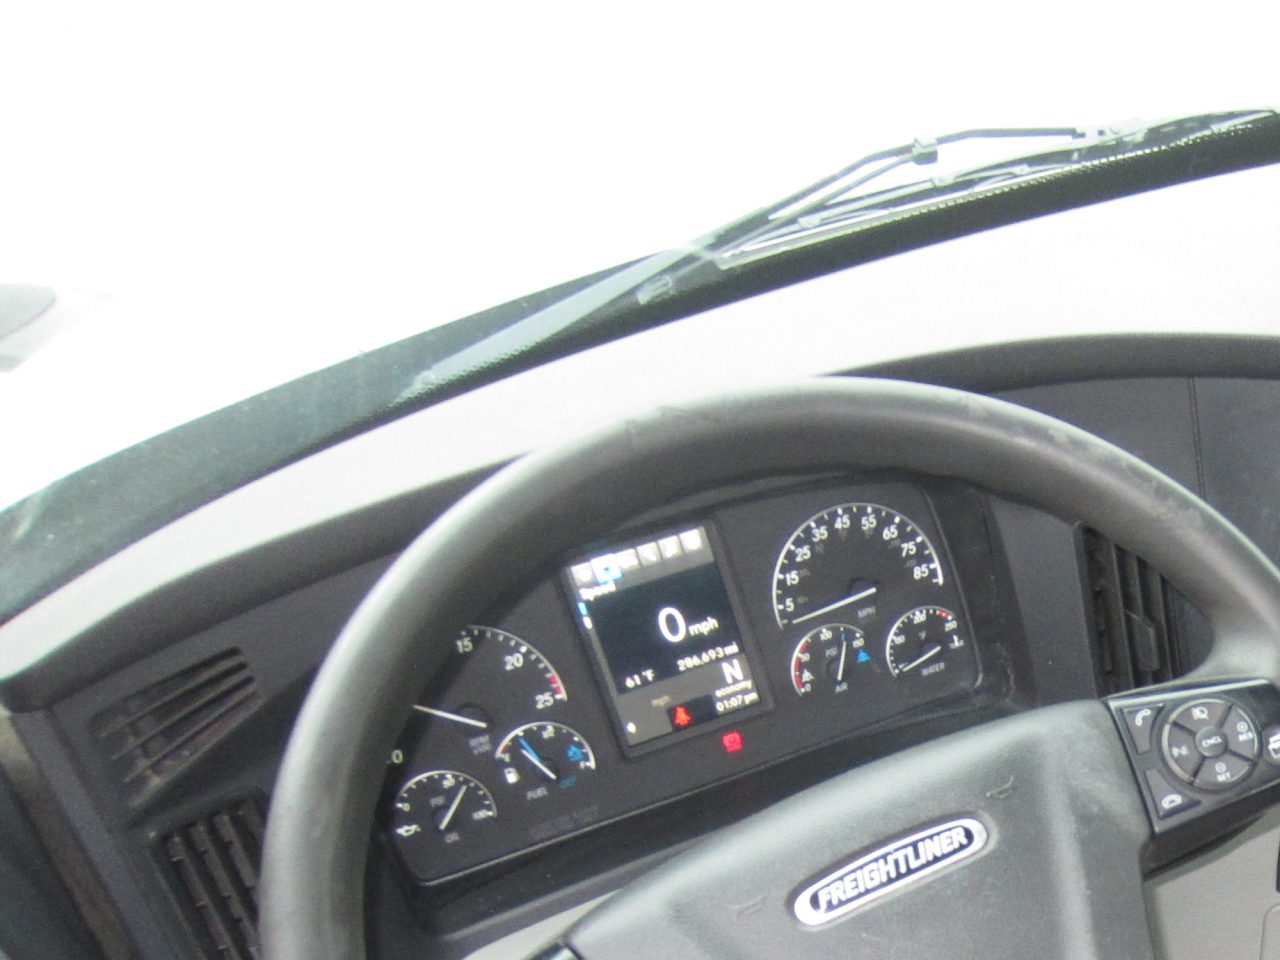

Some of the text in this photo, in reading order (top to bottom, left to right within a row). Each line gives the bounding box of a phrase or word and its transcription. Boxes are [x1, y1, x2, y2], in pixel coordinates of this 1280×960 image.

[834, 514, 851, 529] 45
[861, 514, 877, 531] 55
[811, 526, 828, 542] 35
[882, 525, 899, 541] 65
[795, 545, 811, 563] 25
[901, 541, 917, 558] 75
[785, 570, 800, 586] 15
[913, 564, 930, 580] 85
[785, 598, 795, 612] 5
[657, 607, 719, 643] 0 mph
[456, 637, 473, 654] 15
[504, 653, 524, 672] 20
[721, 659, 745, 684] N
[625, 674, 642, 689] 61
[535, 692, 554, 710] 25
[816, 825, 970, 914] FREIGHTLINER
